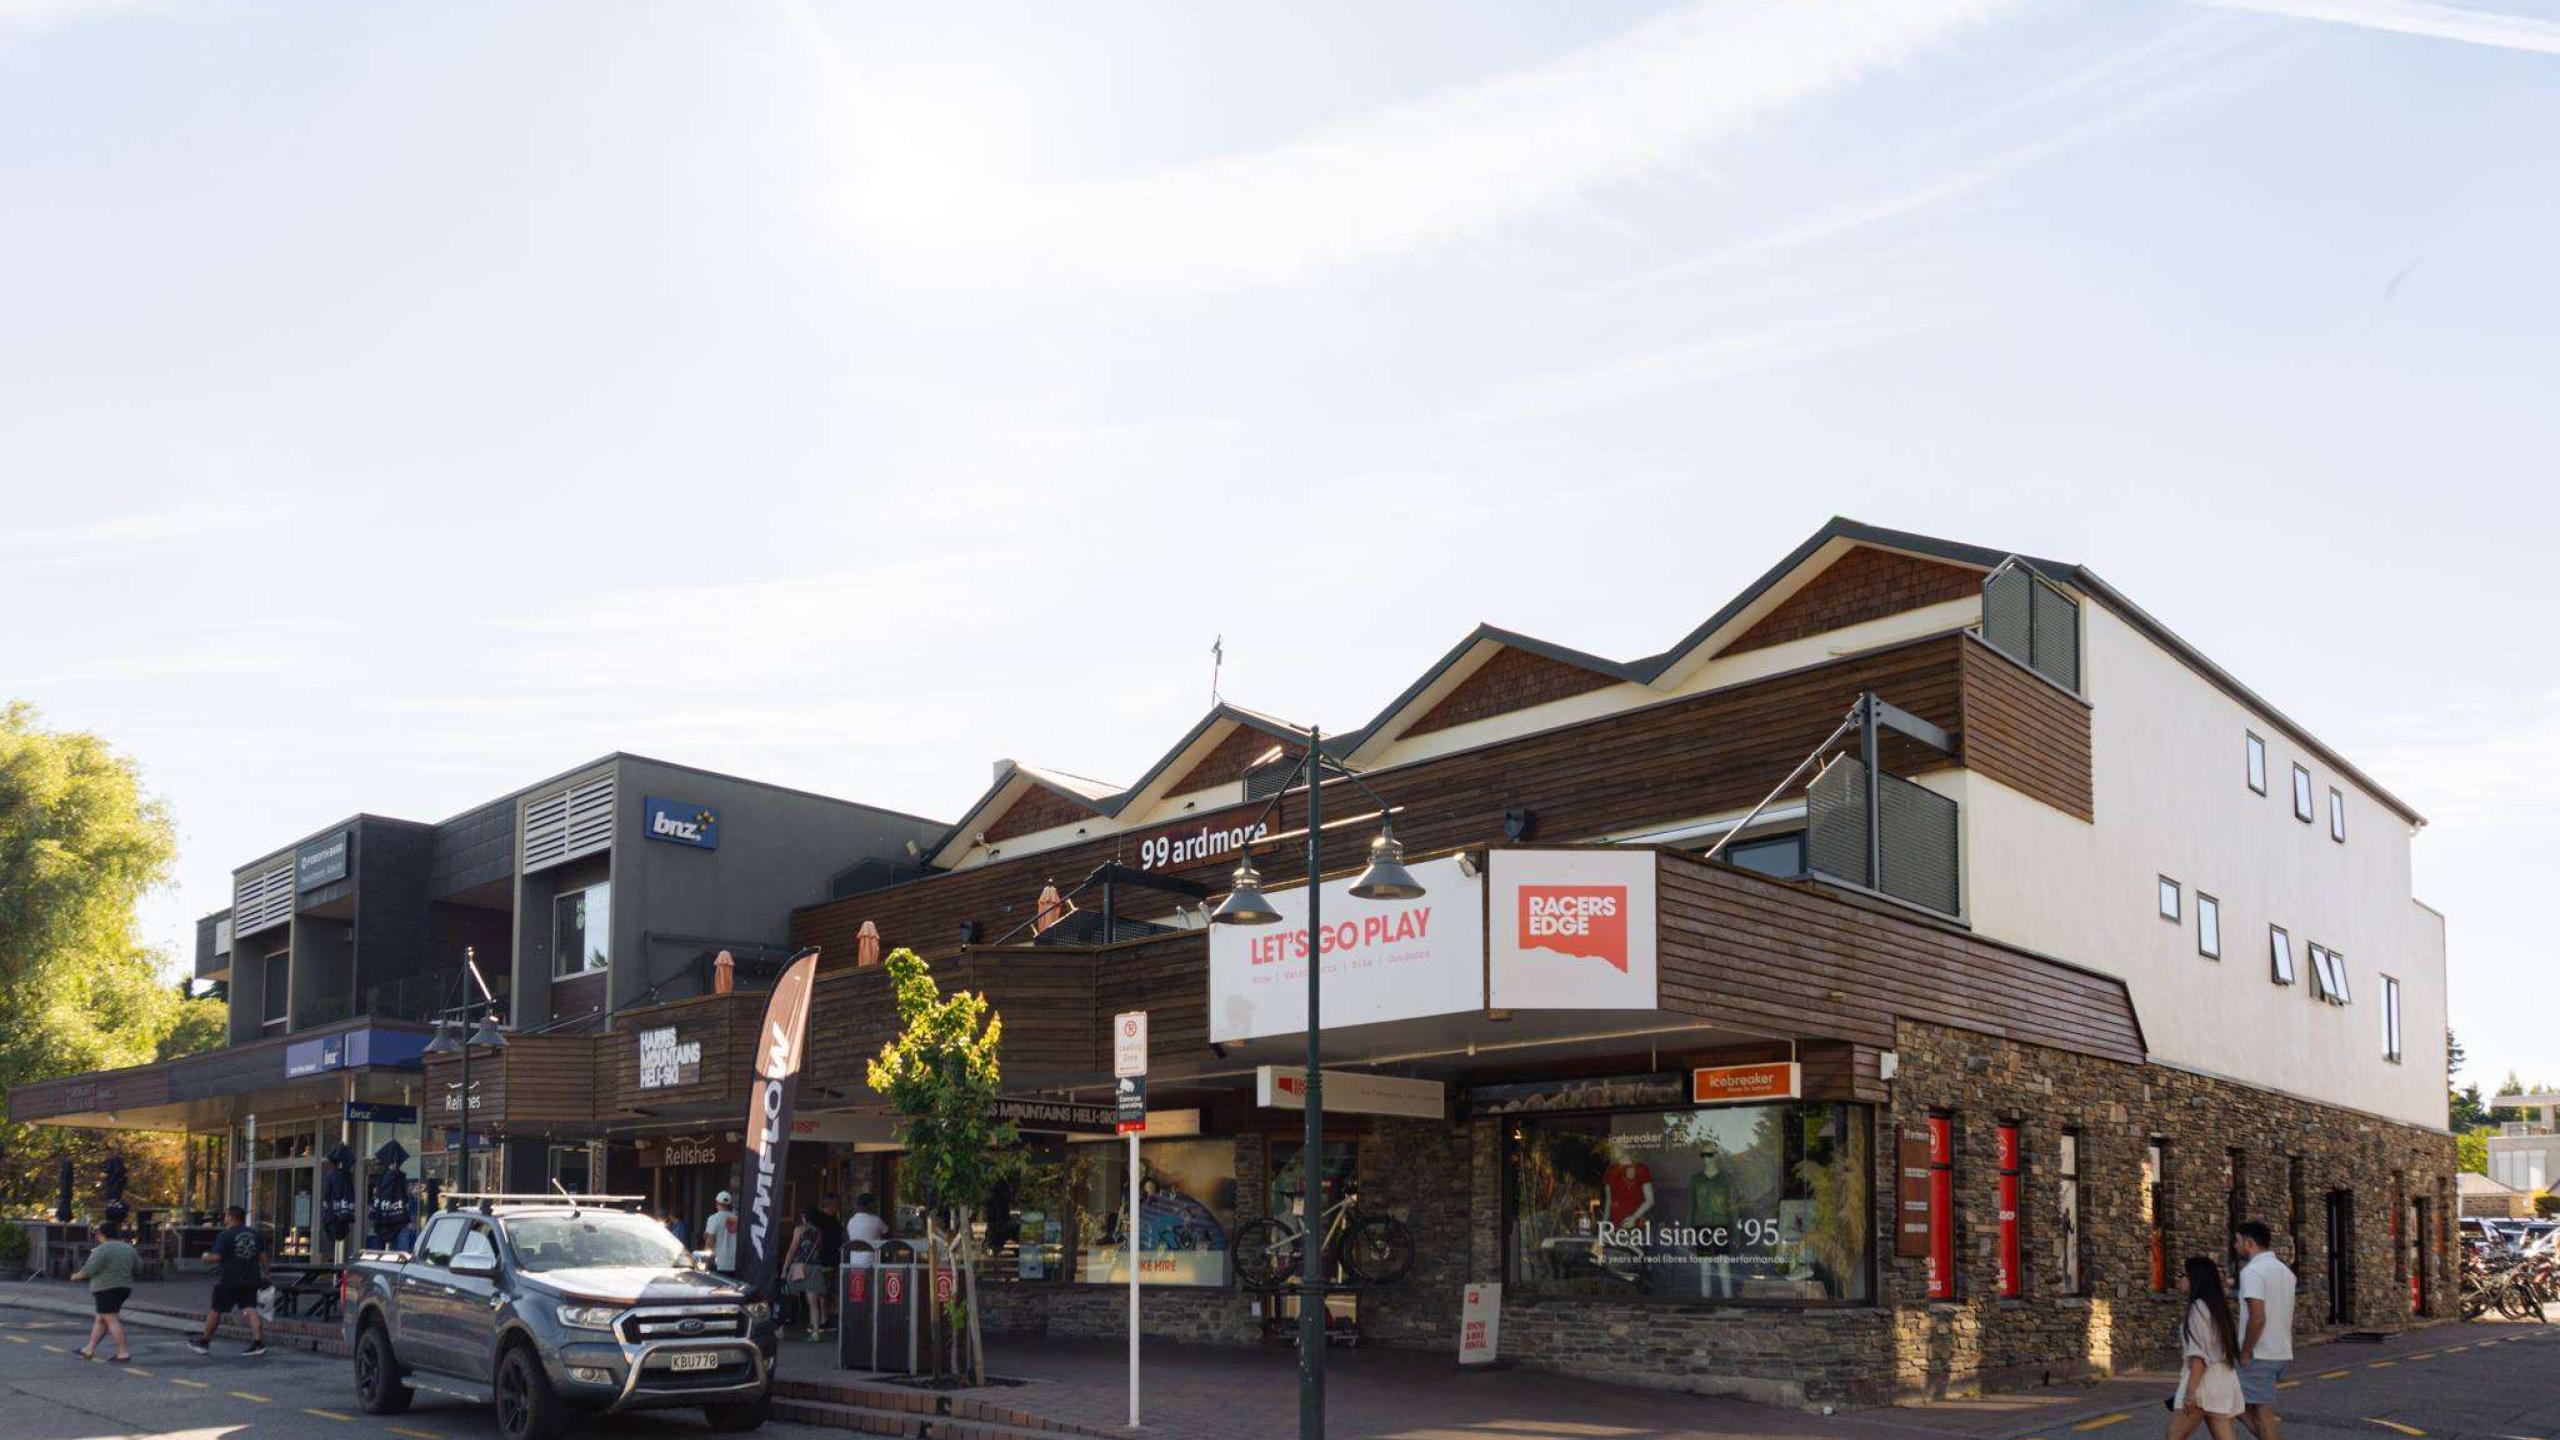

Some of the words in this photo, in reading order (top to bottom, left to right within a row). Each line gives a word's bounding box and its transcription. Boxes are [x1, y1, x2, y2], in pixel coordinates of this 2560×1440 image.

[653, 810, 699, 840] bnz
[1141, 836, 1170, 870] 99
[1172, 822, 1268, 864] ardmore
[1528, 896, 1617, 916] RACERS
[1319, 919, 1359, 954] GO
[1364, 906, 1431, 946] PLAY
[1528, 916, 1590, 936] EDGE
[640, 1026, 677, 1051] HARRIS
[640, 1041, 701, 1069] MOUNTAINS
[640, 1063, 679, 1088] HELI-SKI
[1709, 1071, 1775, 1088] icebreaker
[350, 1107, 372, 1119] bnz
[1608, 1131, 1662, 1144] icebreaker
[665, 1145, 717, 1166] Relishes
[1598, 1219, 1651, 1248] Real
[1658, 1220, 1729, 1247] since
[1154, 1259, 1177, 1274] HIRE
[1608, 1255, 1632, 1266] years
[1634, 1254, 1642, 1264] of
[1643, 1253, 1661, 1264] real
[1662, 1253, 1688, 1264] fibres
